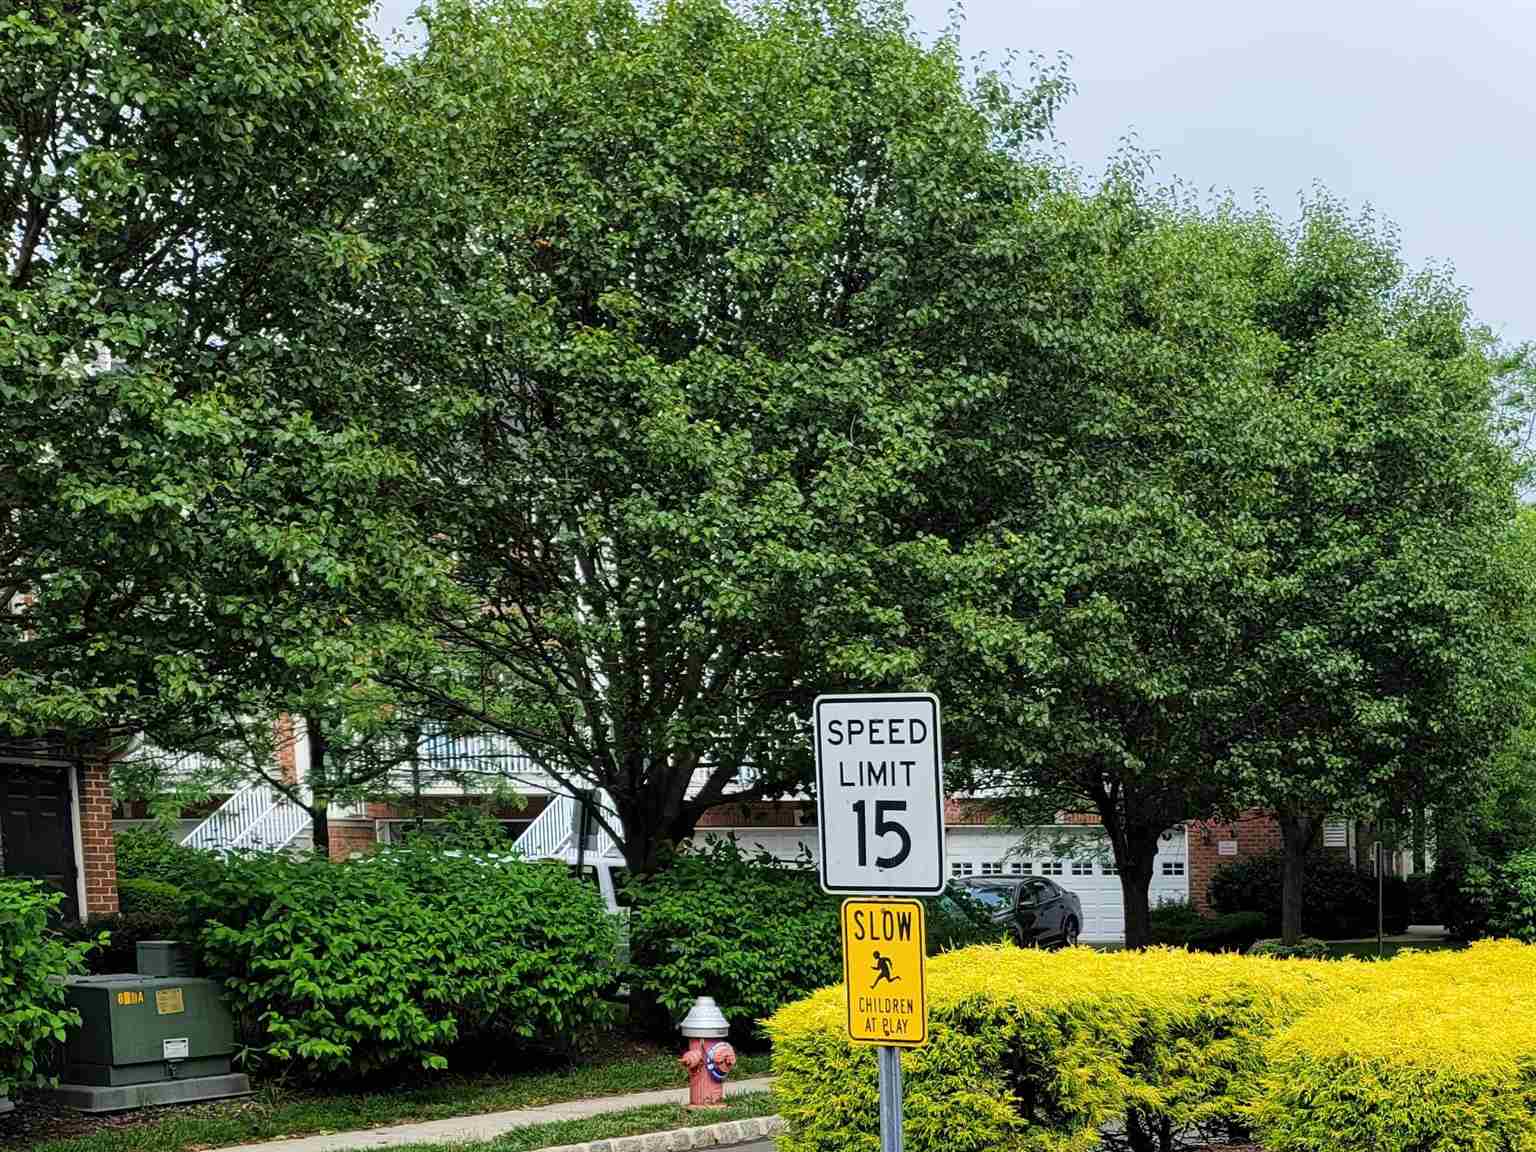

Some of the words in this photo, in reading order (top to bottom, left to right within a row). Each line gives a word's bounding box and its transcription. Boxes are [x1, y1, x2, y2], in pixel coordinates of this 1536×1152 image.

[827, 718, 927, 745] SPEED
[840, 760, 916, 787] LIMIT
[852, 799, 911, 869] 15
[854, 910, 911, 941] SLOW
[859, 997, 913, 1014] CHILDREN
[865, 1017, 877, 1033] AT
[882, 1017, 908, 1034] PLAY
